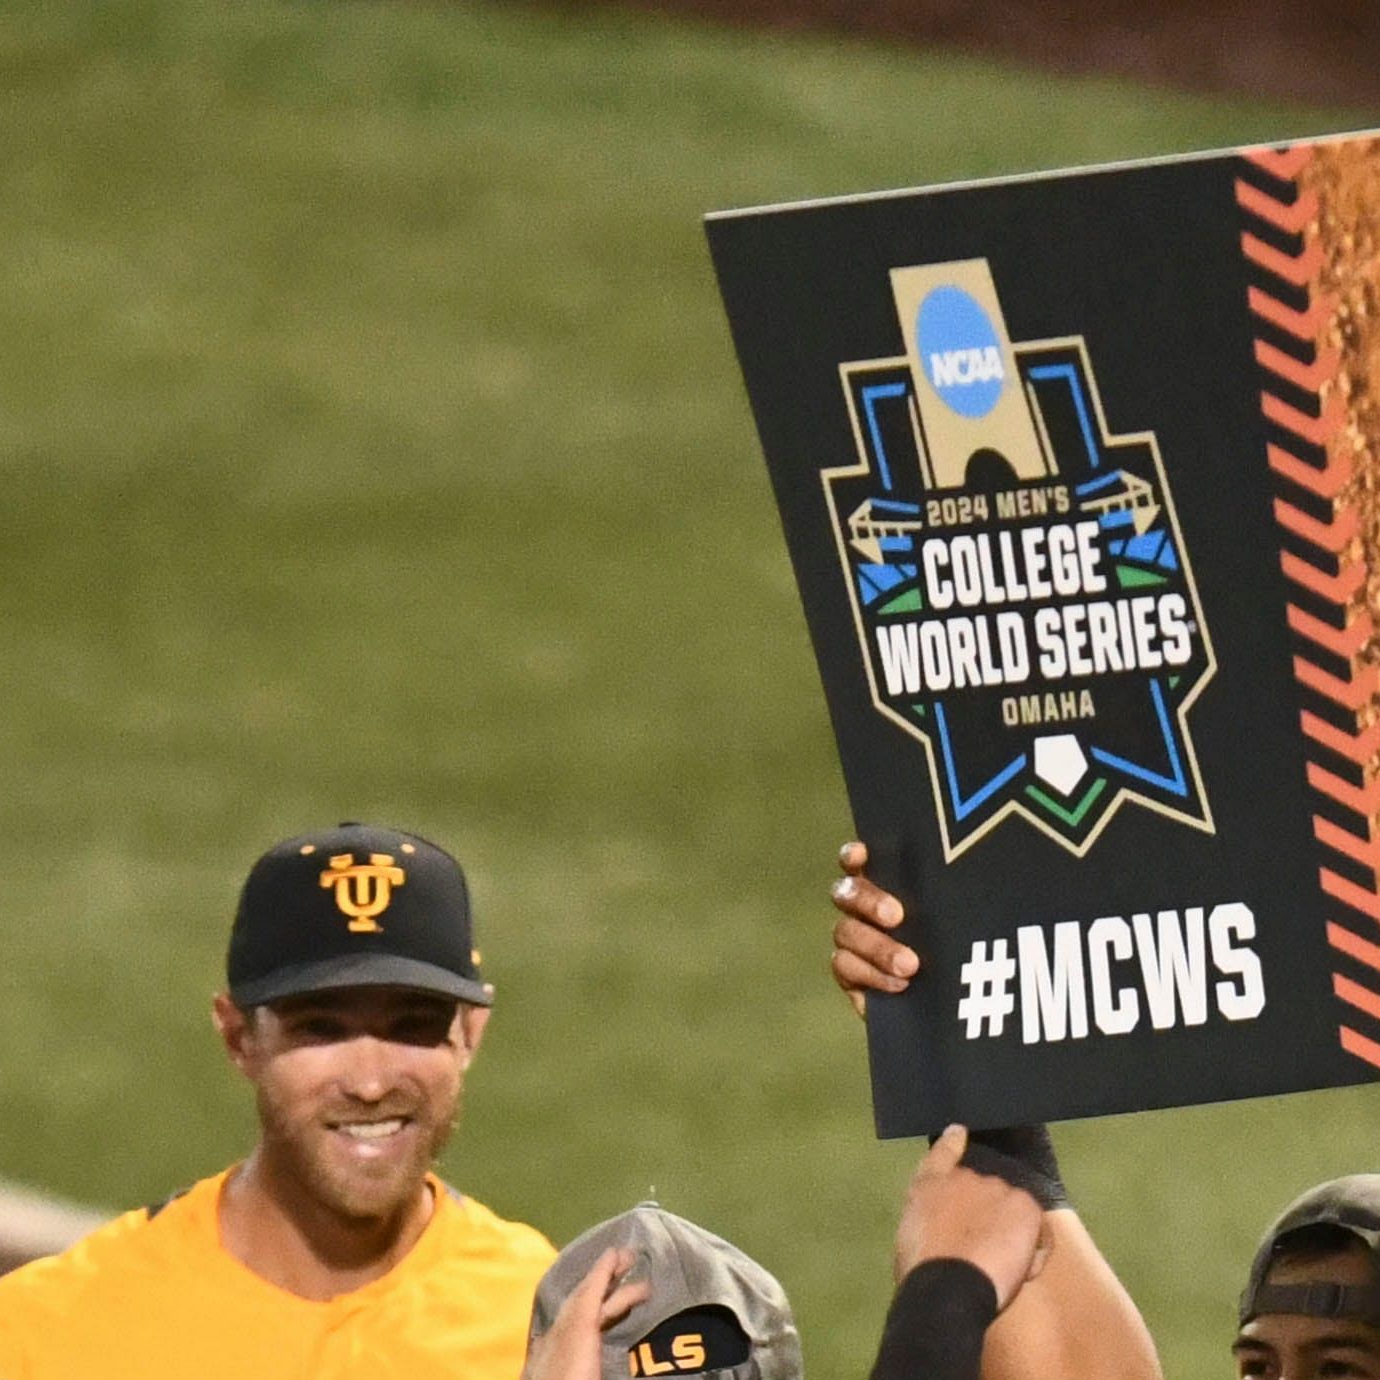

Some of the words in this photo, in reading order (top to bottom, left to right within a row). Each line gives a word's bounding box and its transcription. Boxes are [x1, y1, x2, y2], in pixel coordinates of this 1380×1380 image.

[931, 346, 1004, 388] NCAA
[927, 494, 989, 527] 2024
[996, 485, 1071, 519] MEN'S
[922, 519, 1108, 610] COLLEGE
[875, 613, 1029, 696] WORLD
[1038, 594, 1193, 679] SERIES
[1002, 689, 1096, 727] OMAHA
[957, 902, 1266, 1045] #MCWS
